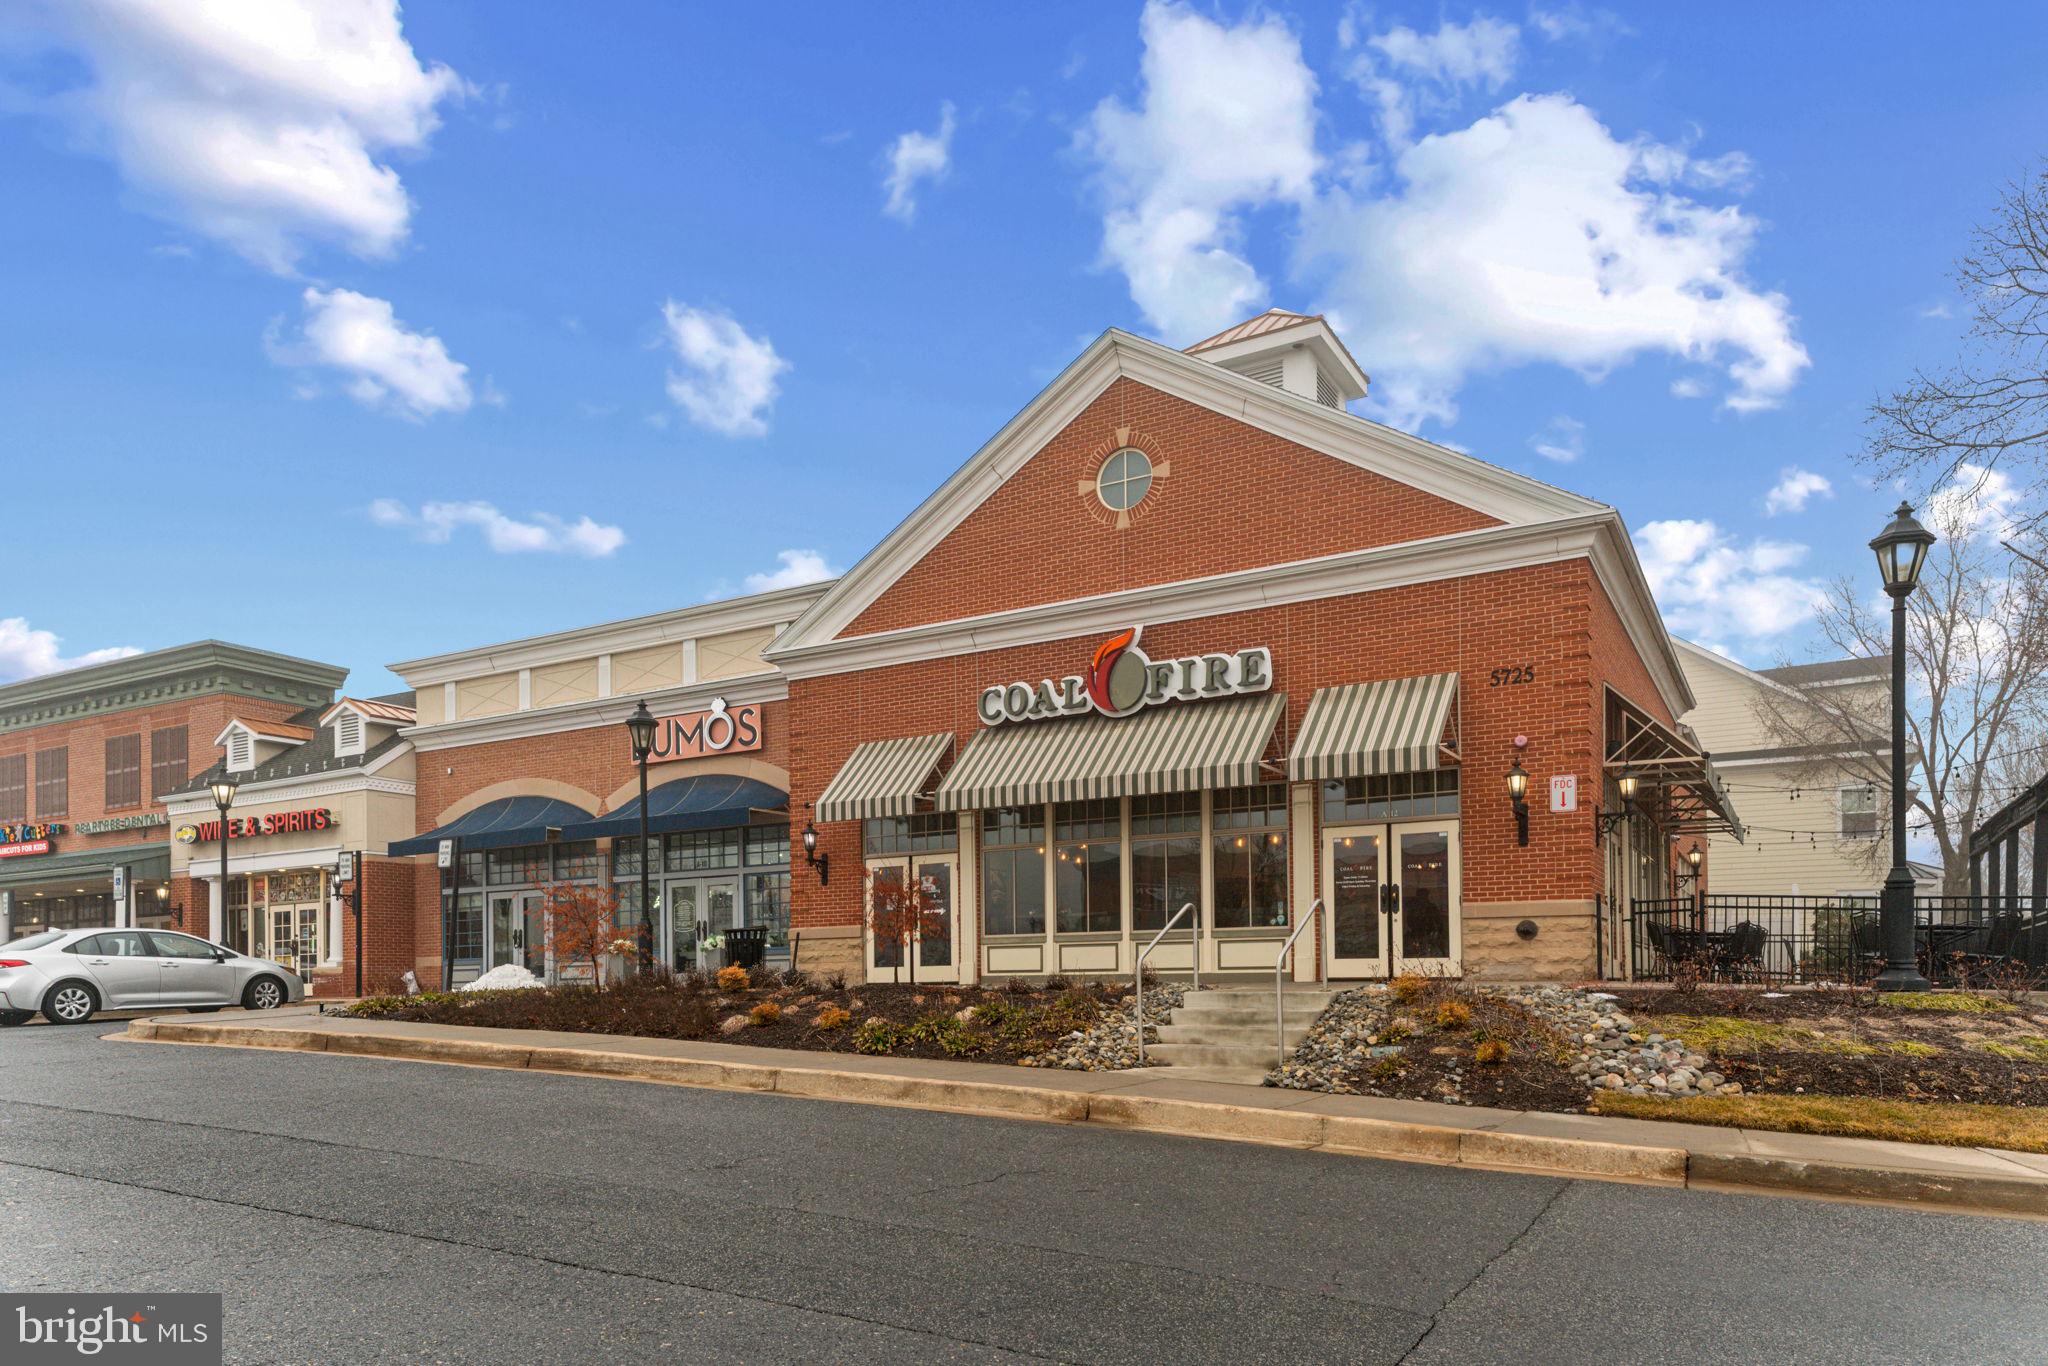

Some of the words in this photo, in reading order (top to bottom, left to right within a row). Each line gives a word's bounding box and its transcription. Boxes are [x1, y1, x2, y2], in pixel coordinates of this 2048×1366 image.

[977, 678, 1088, 721] COAL
[1145, 650, 1267, 700] FIRE
[1490, 665, 1534, 687] 5725
[1554, 779, 1573, 789] FDC
[245, 816, 256, 836] &
[264, 808, 326, 835] SPIRITS
[21, 844, 32, 852] FOR
[33, 842, 46, 851] KIDS
